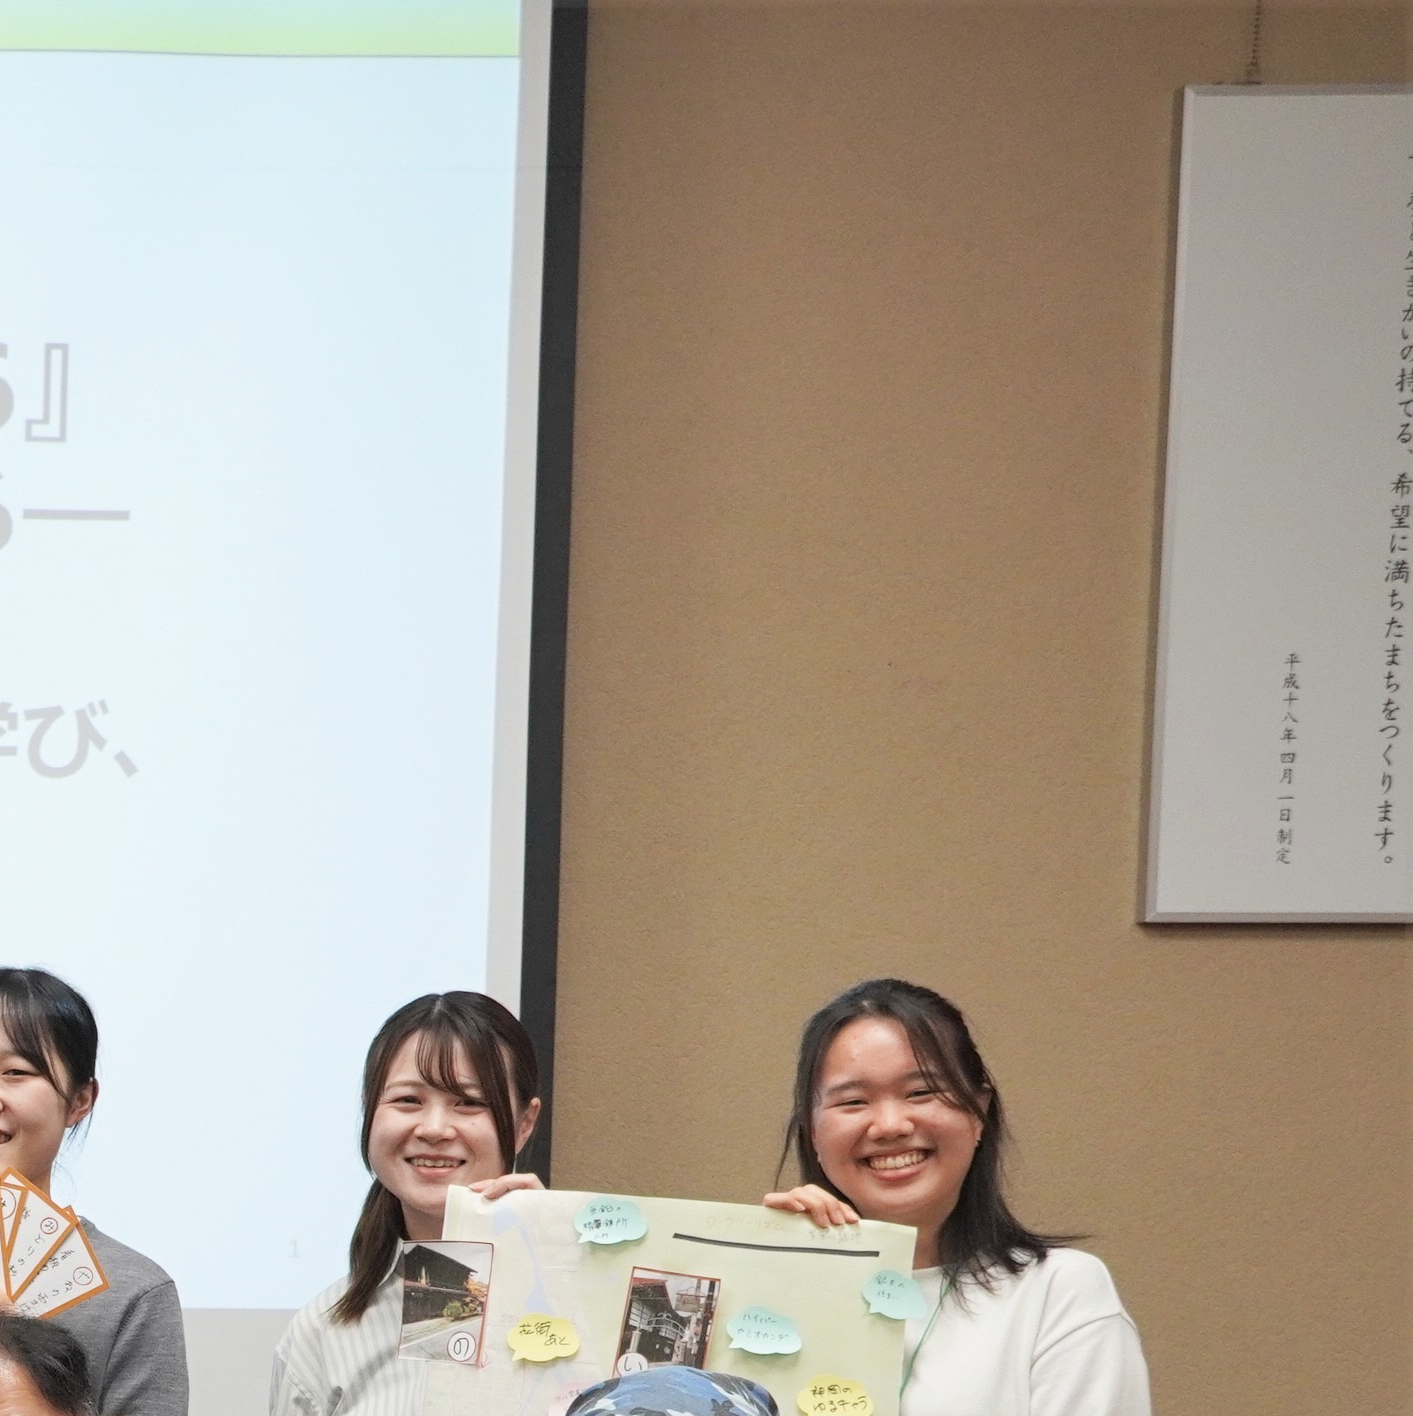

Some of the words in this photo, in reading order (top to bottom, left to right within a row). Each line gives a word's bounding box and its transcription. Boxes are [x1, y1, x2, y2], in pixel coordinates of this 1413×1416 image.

[1276, 651, 1301, 865] 平成十八年四月一日制定
[454, 1339, 470, 1356] の
